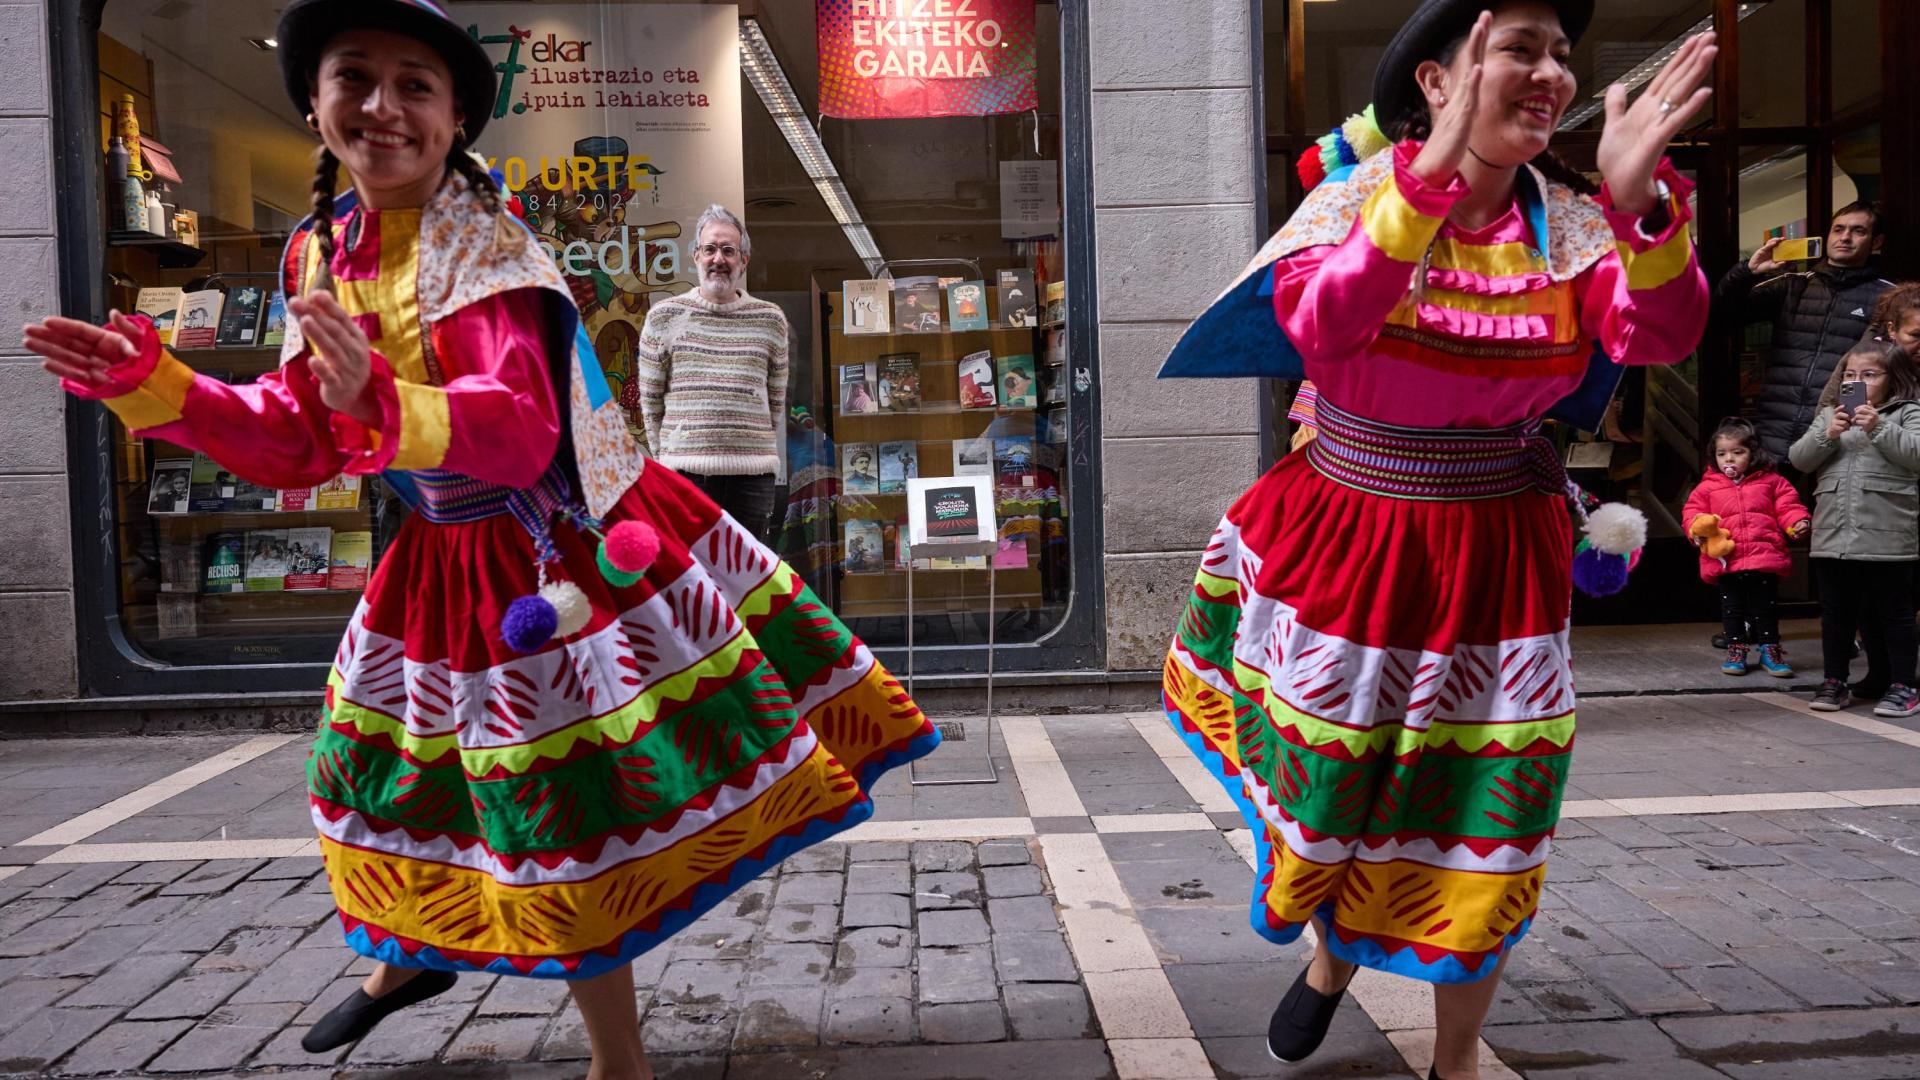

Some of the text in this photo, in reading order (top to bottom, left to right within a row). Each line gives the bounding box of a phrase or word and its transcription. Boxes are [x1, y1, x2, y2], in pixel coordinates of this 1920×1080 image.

[852, 19, 1008, 48] EKITEKO.
[531, 34, 592, 62] elkar
[530, 67, 699, 84] ilustrazio eta
[853, 49, 992, 78] GARAIA
[522, 91, 710, 112] ipuin lehiaketa
[540, 155, 652, 192] URTE
[208, 564, 240, 578] RECLUSO
